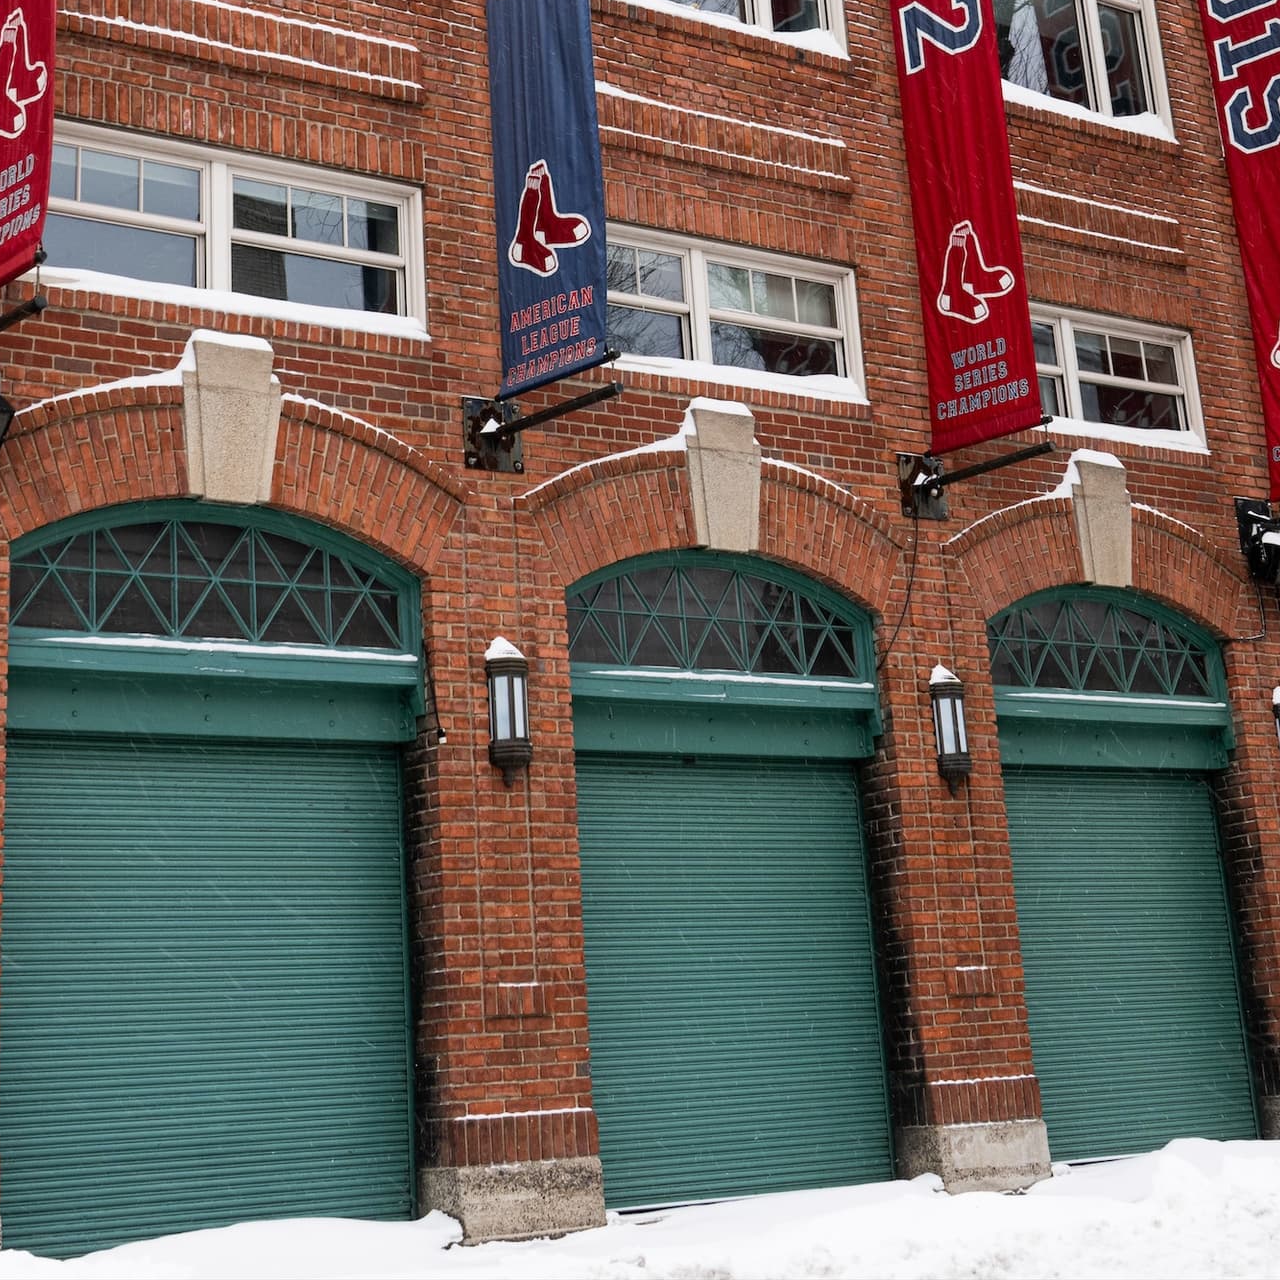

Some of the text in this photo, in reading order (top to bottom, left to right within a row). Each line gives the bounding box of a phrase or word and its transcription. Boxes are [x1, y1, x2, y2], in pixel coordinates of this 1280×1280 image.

[510, 286, 593, 333] AMERICAN
[521, 316, 581, 356] LEAGUE
[951, 337, 1007, 370] WORLD
[507, 336, 597, 387] CHAMPIONS
[954, 361, 1008, 393] SERIES
[937, 378, 1029, 420] CHAMPIONS
